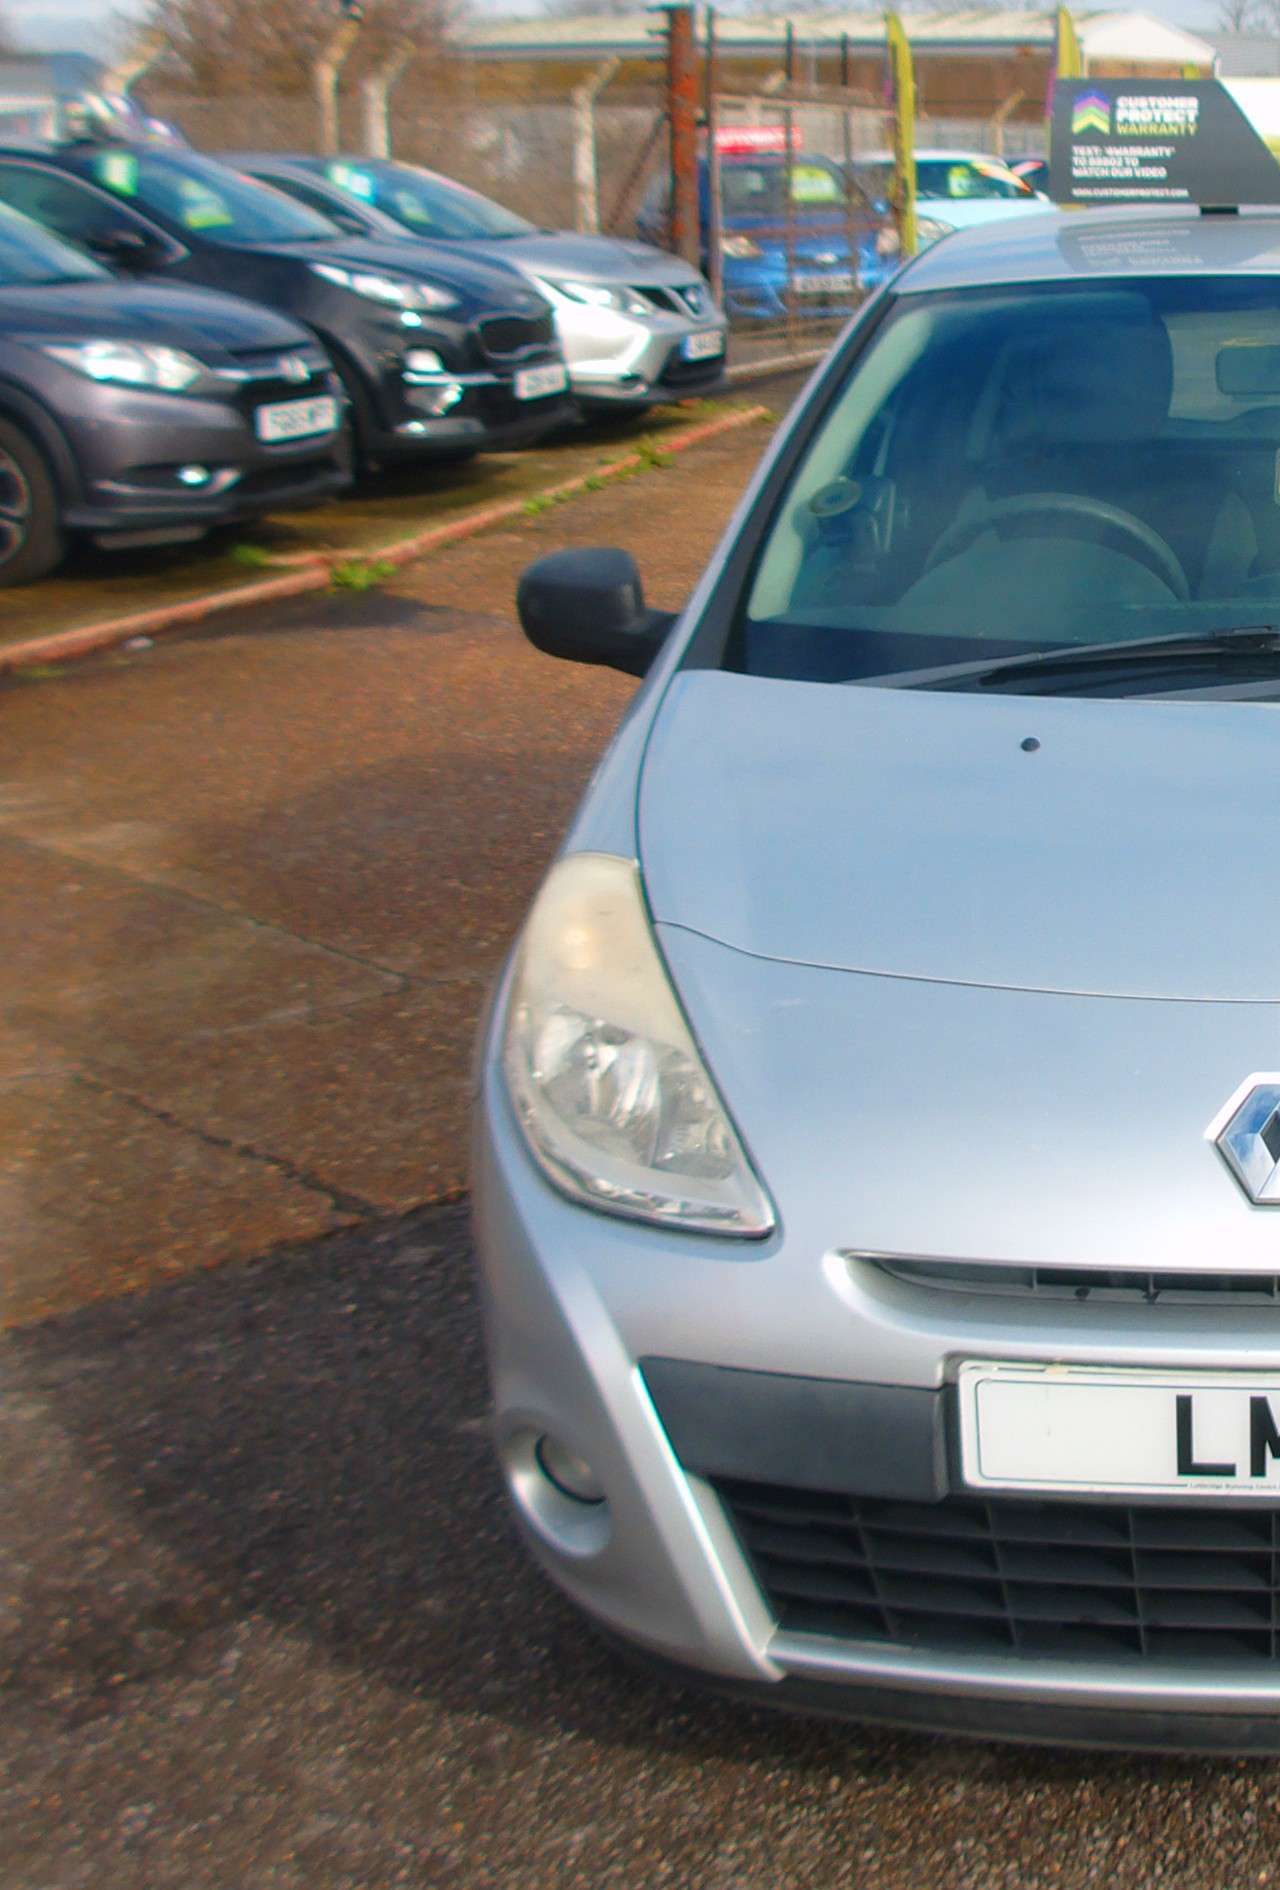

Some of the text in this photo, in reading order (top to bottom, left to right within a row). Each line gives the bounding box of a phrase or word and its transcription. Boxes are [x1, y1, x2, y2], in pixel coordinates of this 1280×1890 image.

[1117, 96, 1198, 109] CUSTOMER
[1117, 109, 1198, 122] PROTECT
[1117, 122, 1197, 135] WARRANTY
[1134, 166, 1168, 178] VIDEO
